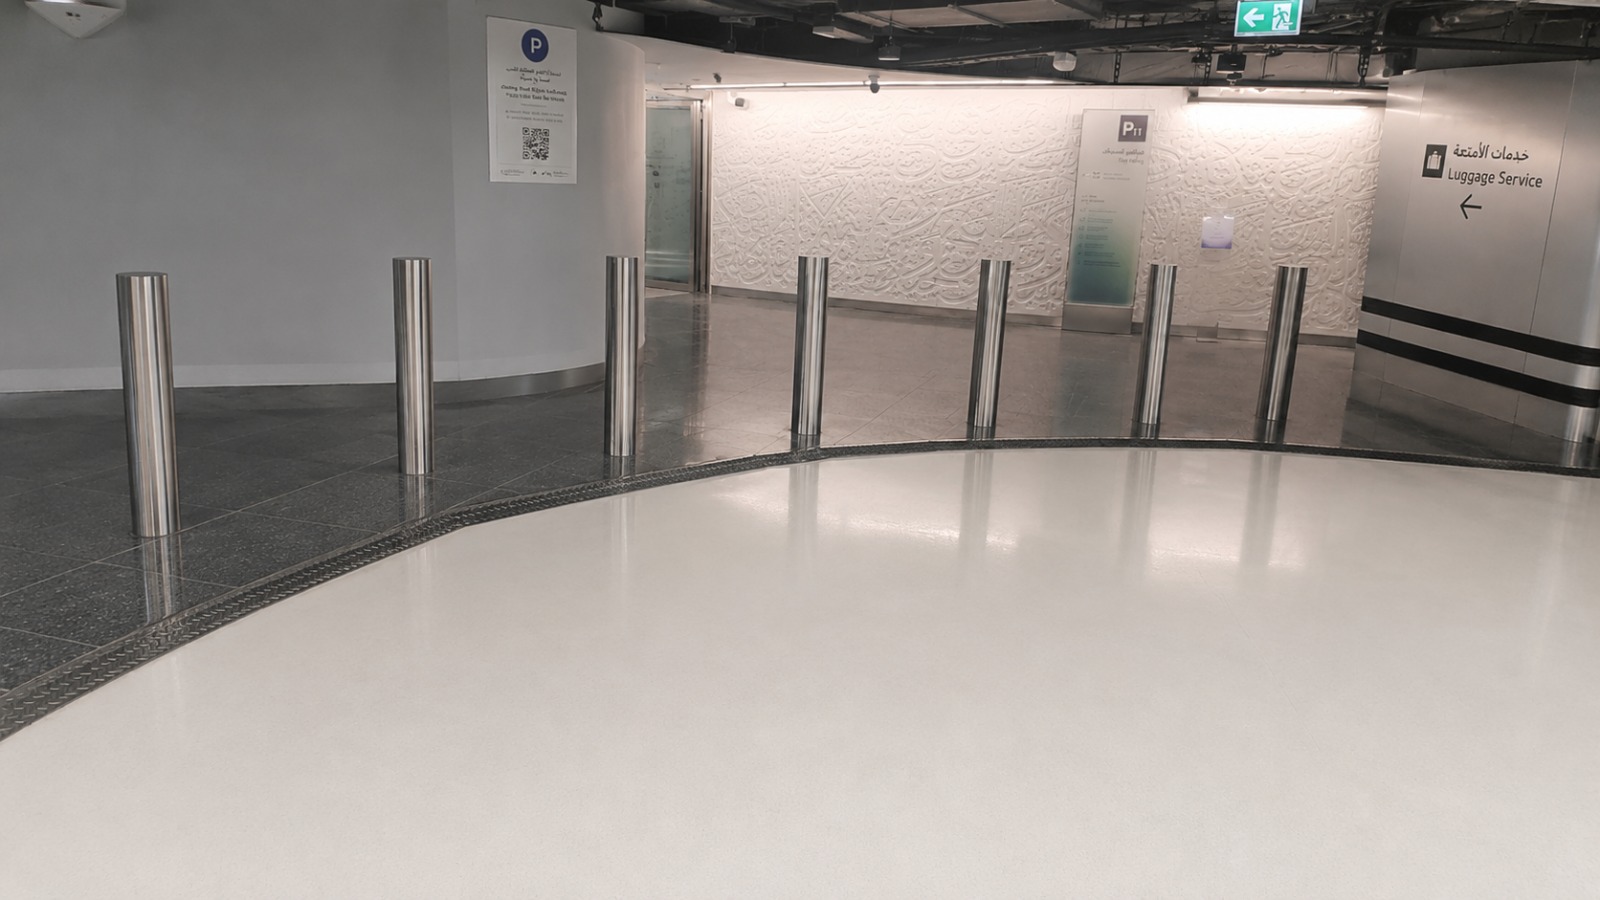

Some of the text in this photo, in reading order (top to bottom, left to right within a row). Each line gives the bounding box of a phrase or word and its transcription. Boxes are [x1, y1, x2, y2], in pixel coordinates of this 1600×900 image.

[530, 37, 542, 54] P
[1453, 142, 1529, 164] خدمات الأمتعة
[1448, 168, 1543, 188] Luggage Service
